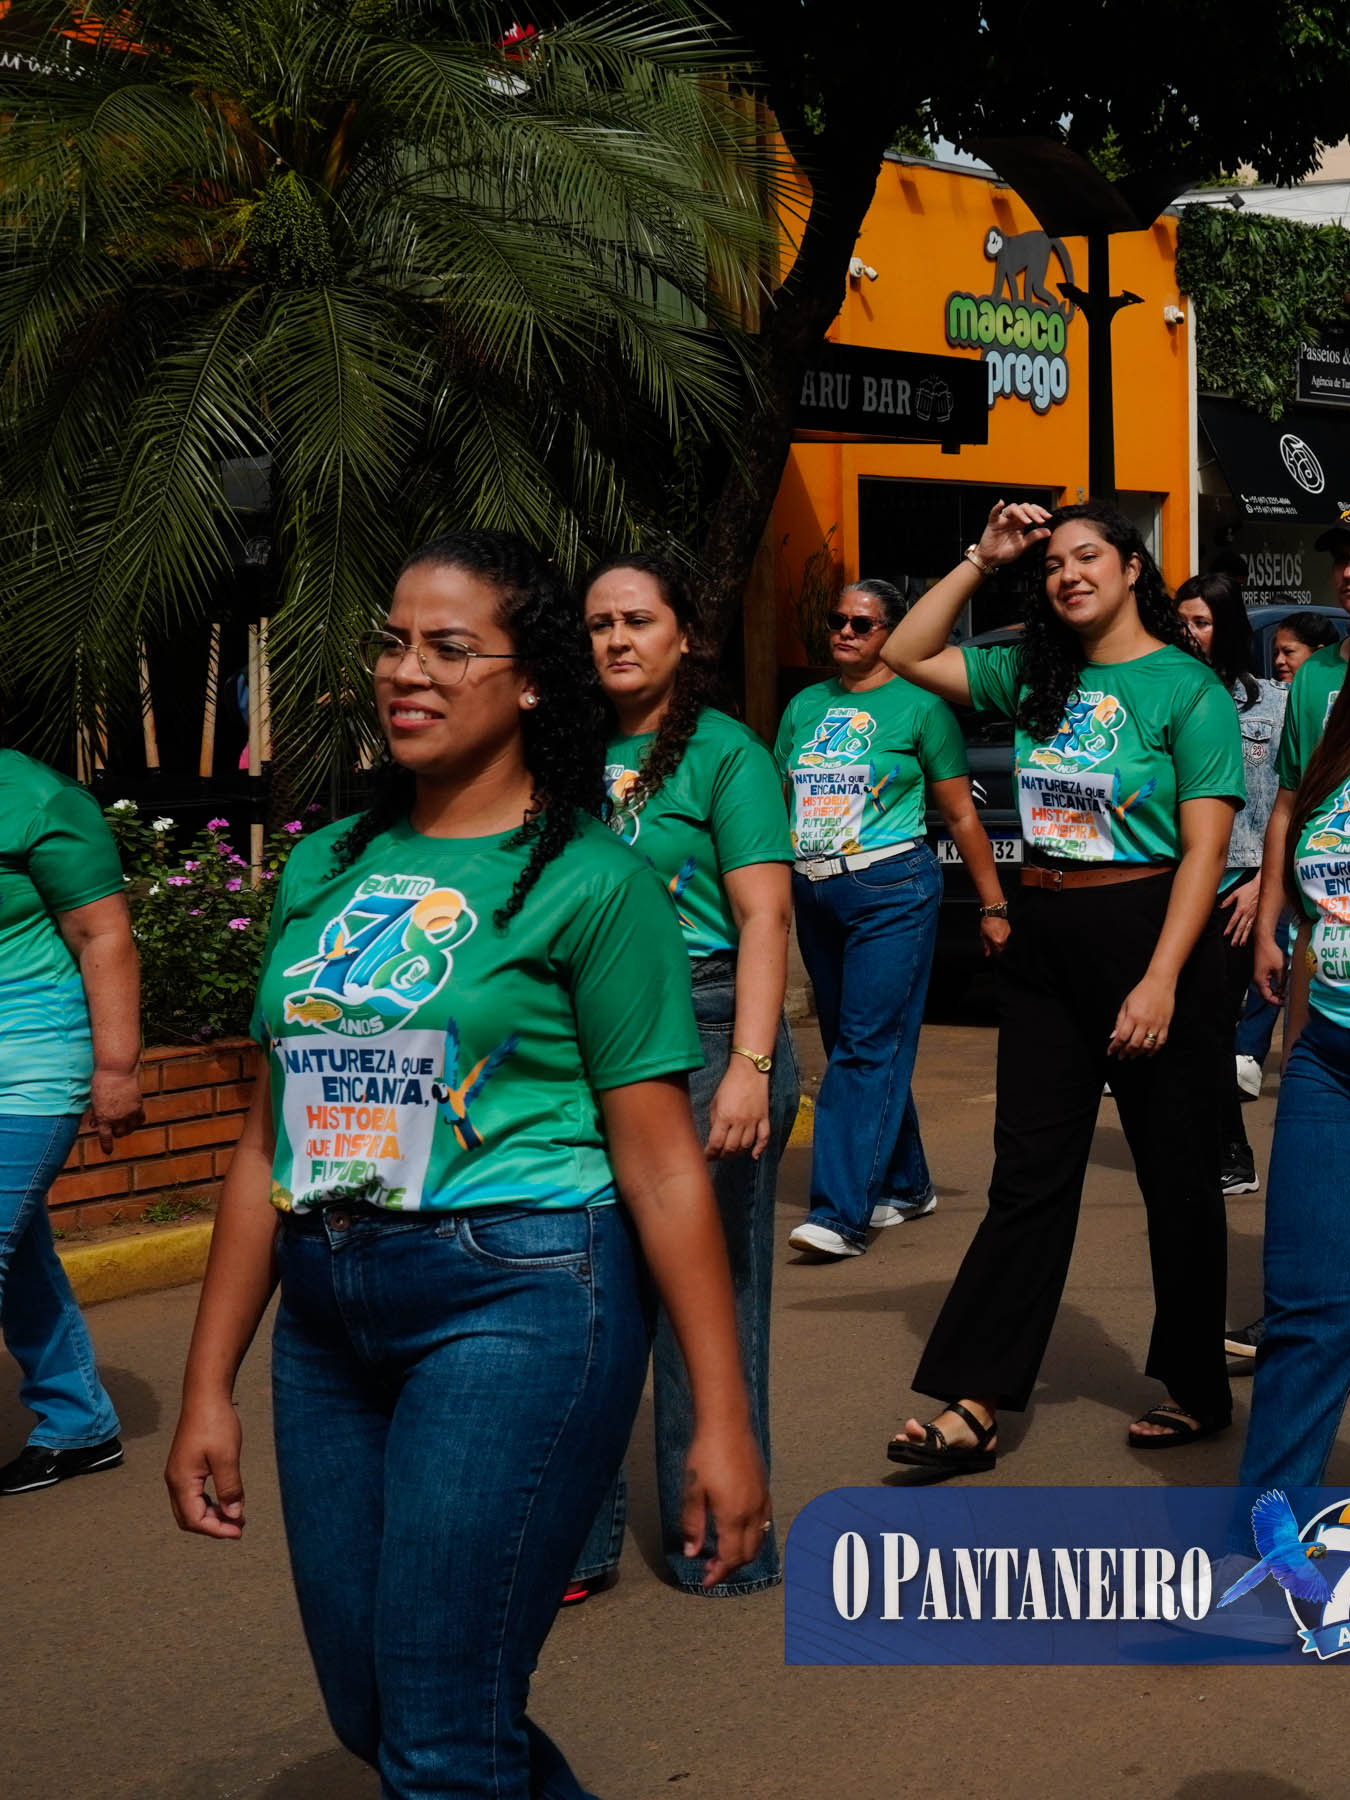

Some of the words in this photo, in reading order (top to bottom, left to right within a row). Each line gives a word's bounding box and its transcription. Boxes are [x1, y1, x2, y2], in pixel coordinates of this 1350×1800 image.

[950, 296, 1065, 354] macaco
[1300, 342, 1340, 363] Passeios
[1342, 348, 1350, 365] &
[986, 351, 1067, 408] prego
[863, 376, 911, 415] BAR
[813, 712, 876, 757] 78
[795, 773, 845, 784] NATUREZA
[848, 775, 865, 784] QUE
[1021, 775, 1082, 794] NATUREZA
[1085, 787, 1105, 799] QUE
[1032, 825, 1047, 836] QUE
[310, 888, 478, 1008] 78
[1320, 948, 1339, 960] QUE
[1342, 947, 1348, 958] A
[338, 1015, 384, 1035] ANOS
[284, 1049, 396, 1074] NATUREZA
[401, 1057, 434, 1077] QUE
[306, 1139, 332, 1158] QUE
